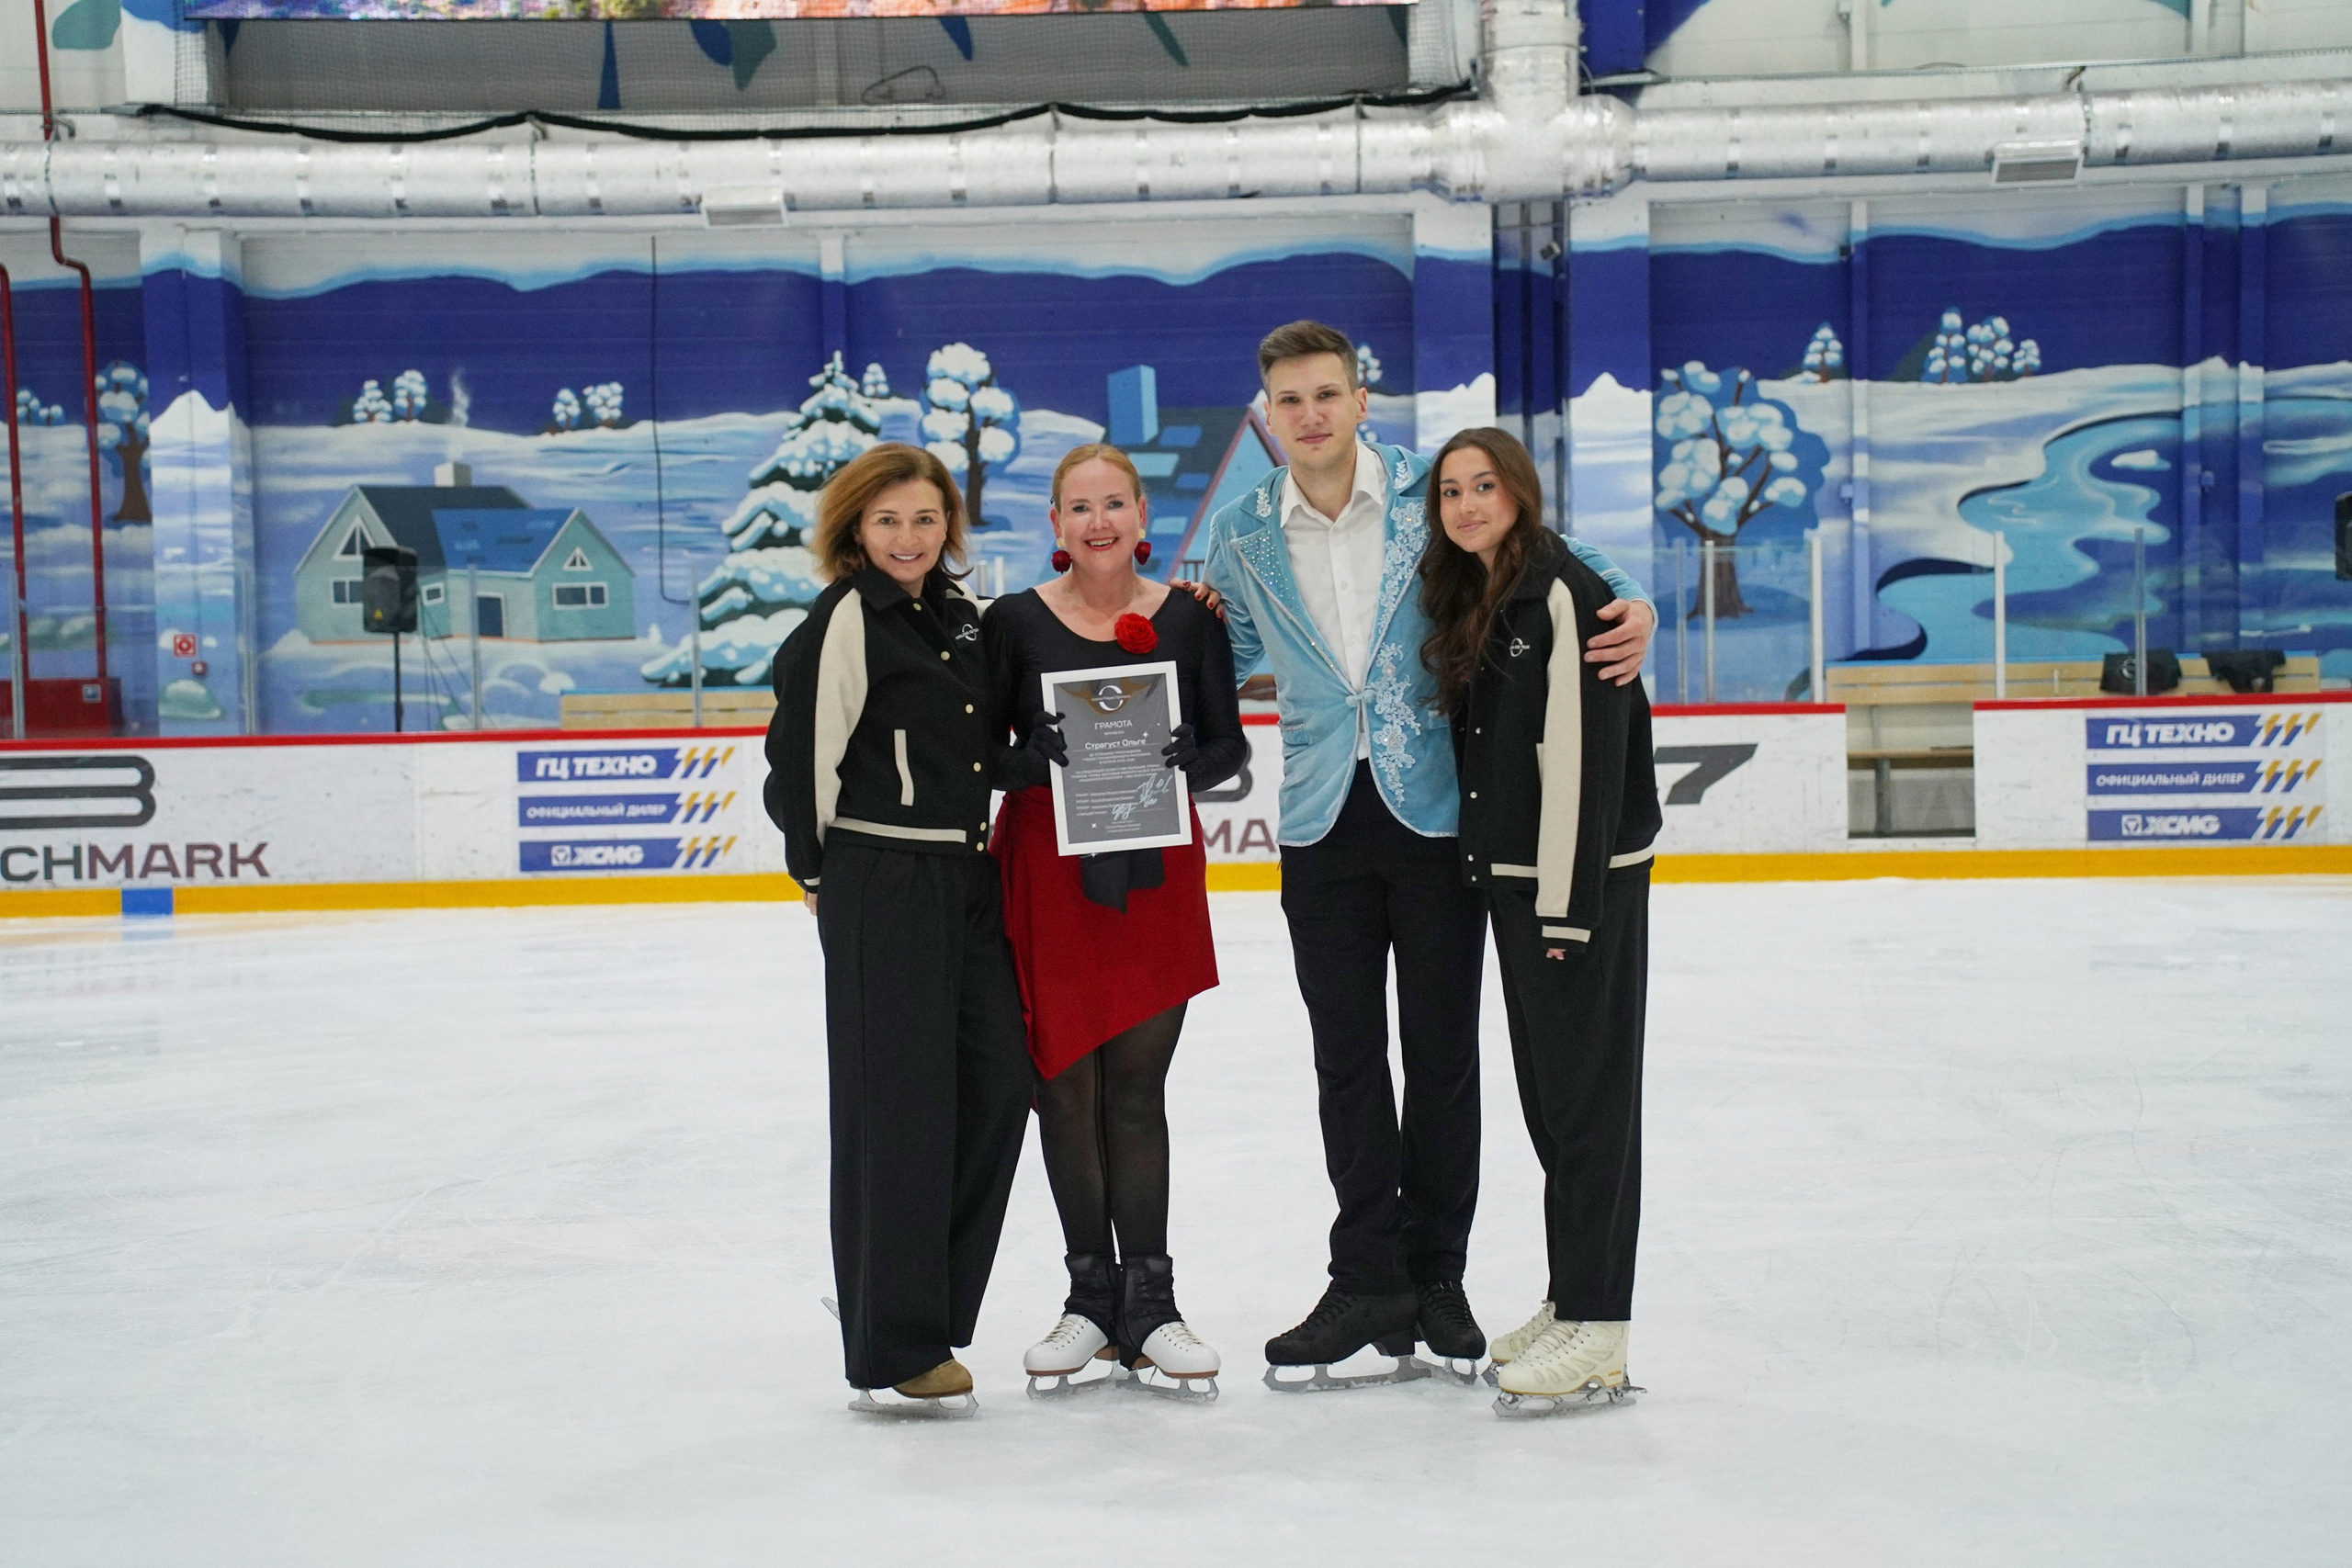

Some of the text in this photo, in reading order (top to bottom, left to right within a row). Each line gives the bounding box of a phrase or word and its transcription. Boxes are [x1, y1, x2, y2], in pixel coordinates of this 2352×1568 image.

[1094, 719, 1133, 730] ГРАМОТА
[2107, 722, 2235, 747] ГЦ ТЕХНО
[1122, 739, 1146, 747] Ольге
[536, 755, 657, 780] ГЦ ТЕХНО
[2097, 771, 2245, 787] ОФИЦИАЛЬНЫЙ ДИЛЕР
[526, 803, 667, 819] ОФИЦИАЛЬНЫЙ ДИЛЕР
